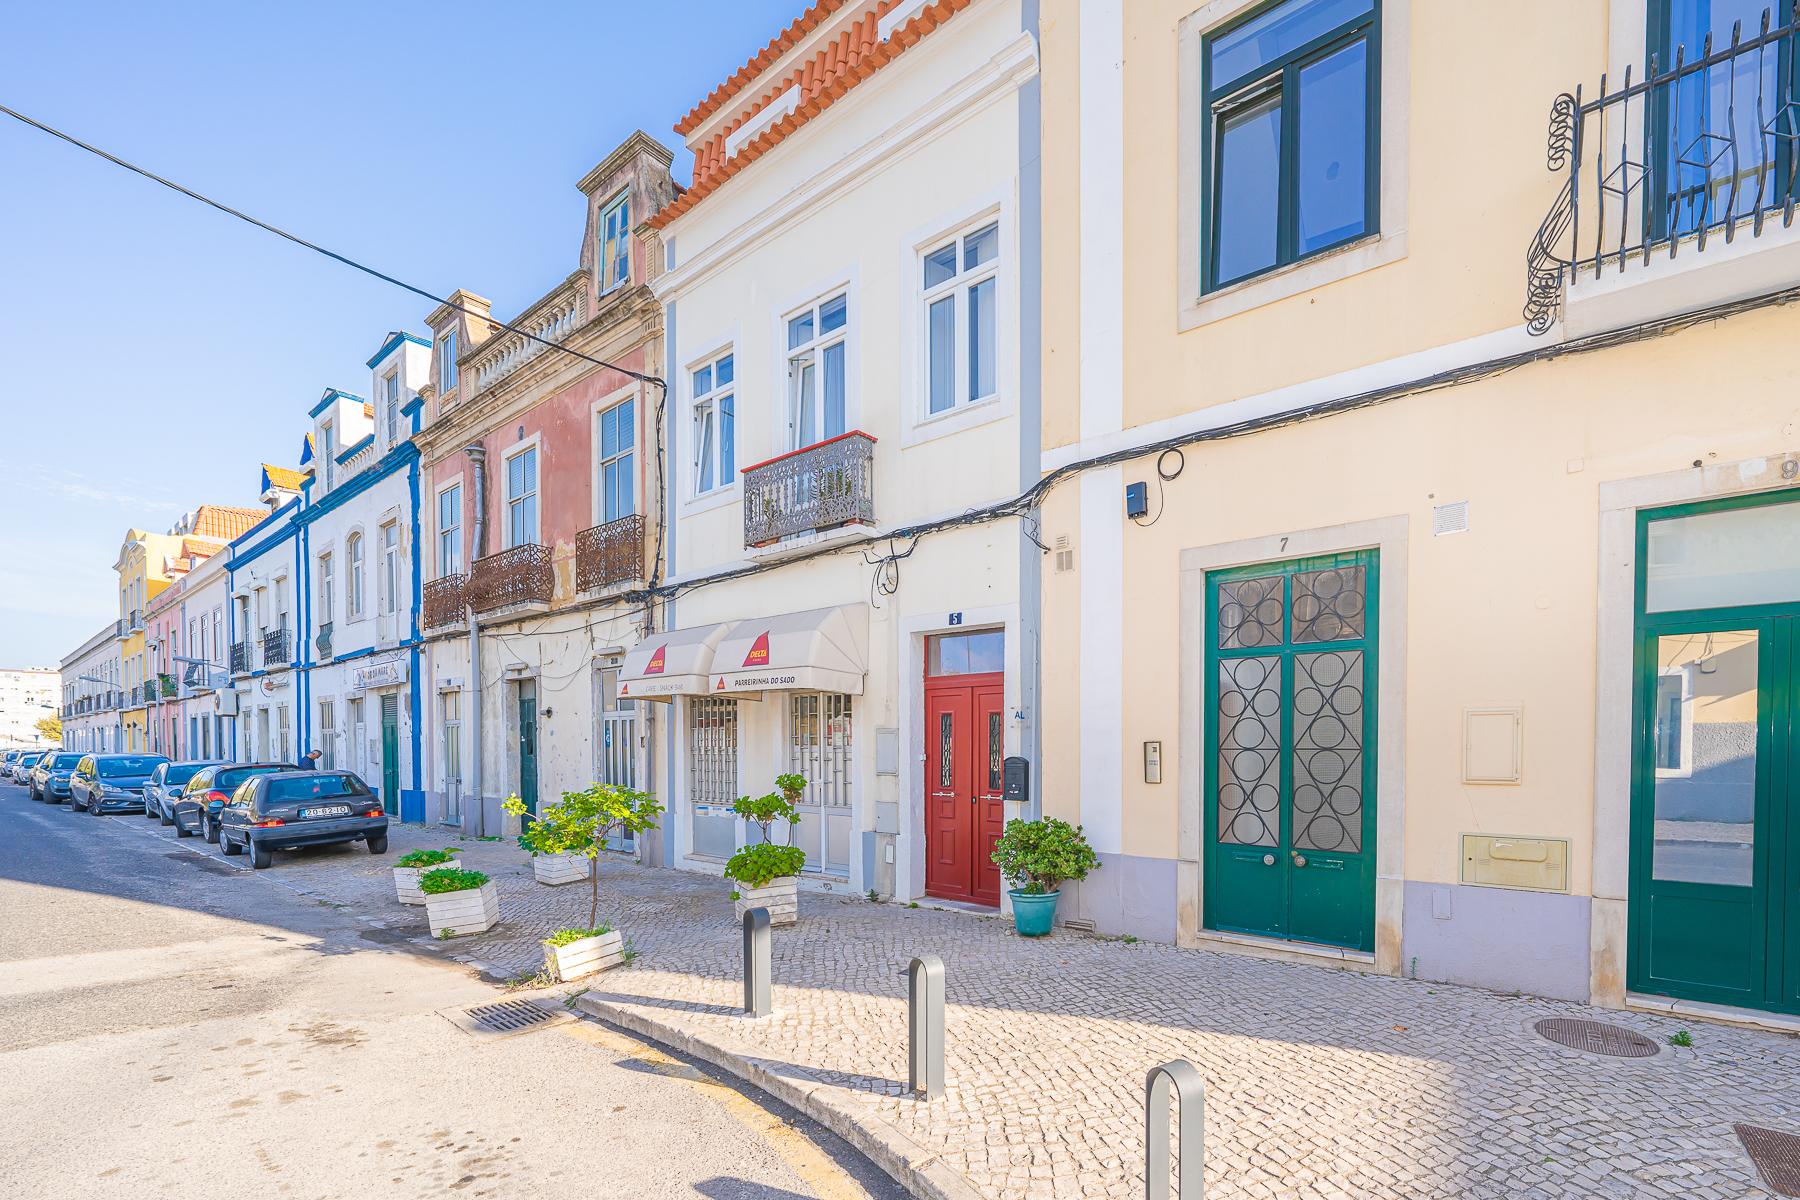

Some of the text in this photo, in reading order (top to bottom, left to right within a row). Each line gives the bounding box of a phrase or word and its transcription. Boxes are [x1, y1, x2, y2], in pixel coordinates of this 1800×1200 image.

[1782, 460, 1799, 480] 9
[1280, 537, 1288, 552] 7
[952, 612, 958, 625] 5
[750, 649, 767, 658] DELTA
[735, 678, 769, 687] PARREIRINHA
[779, 676, 795, 684] SADO
[1015, 711, 1025, 720] AL
